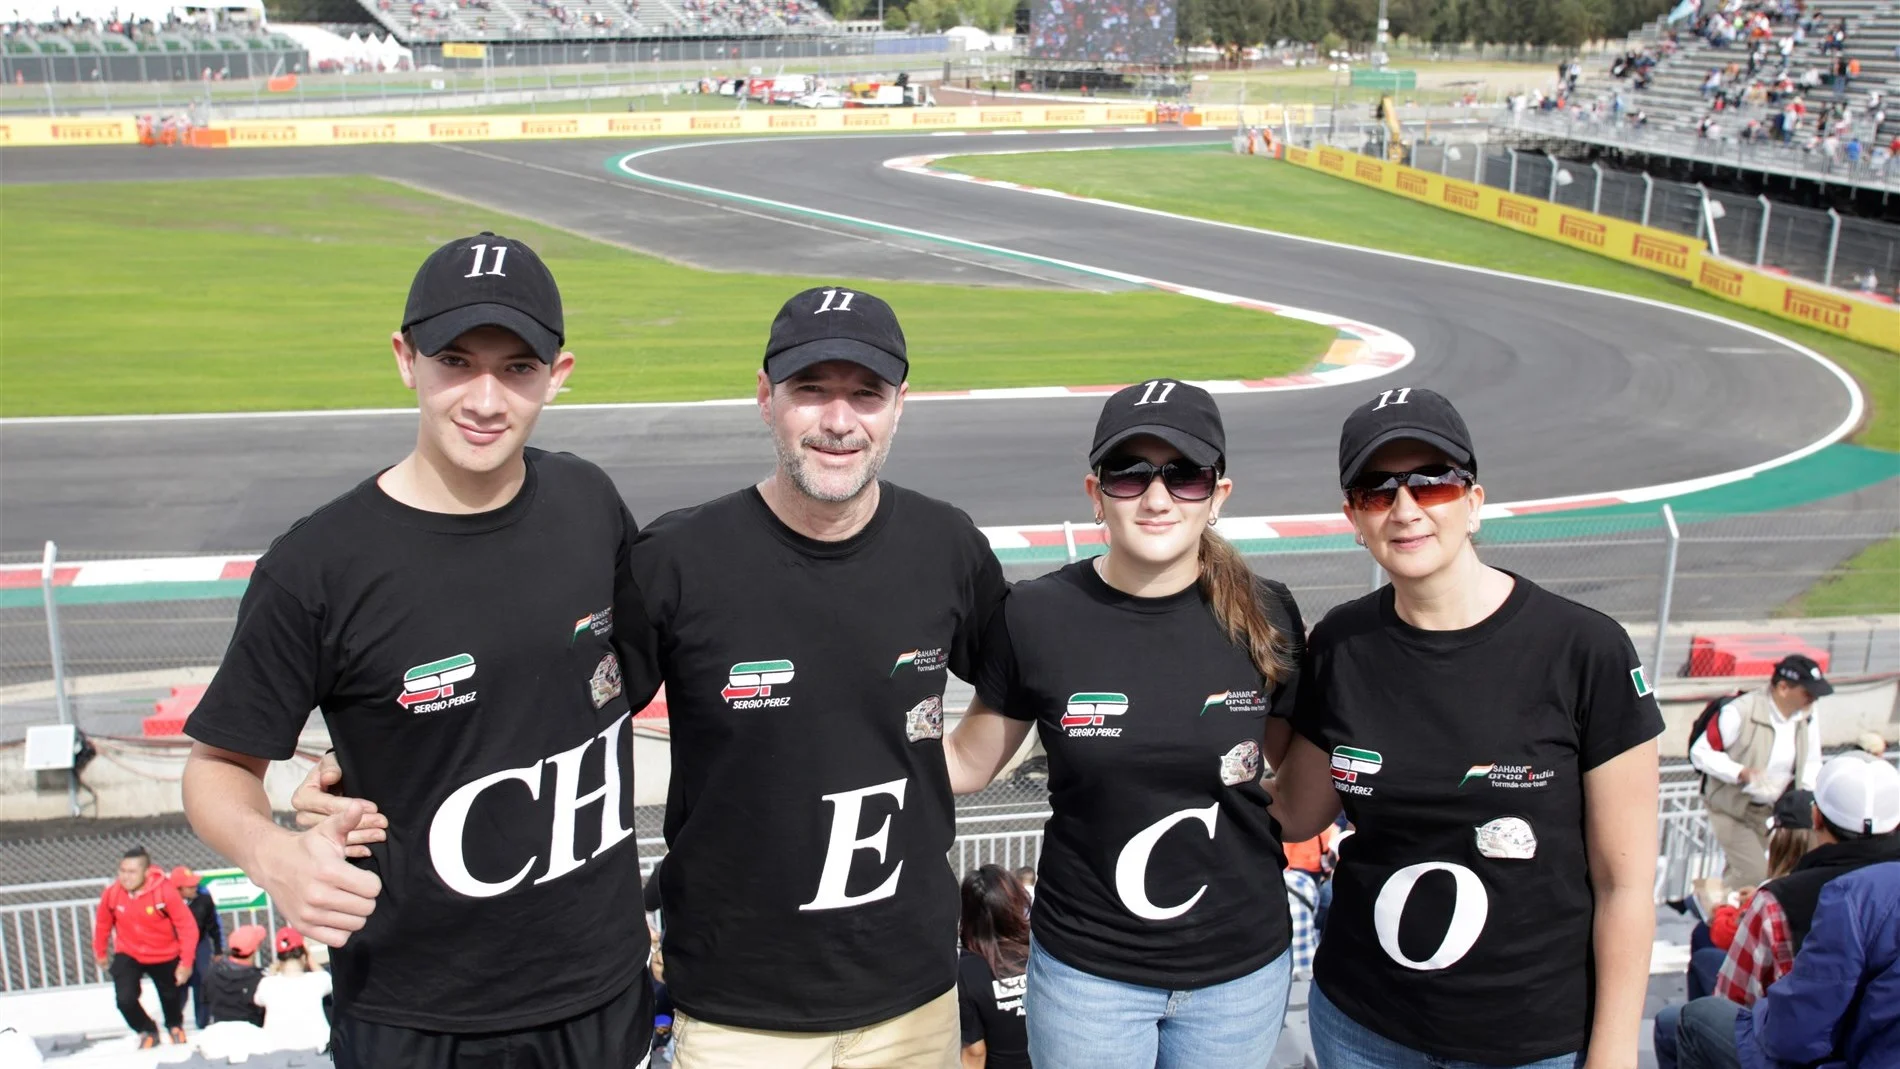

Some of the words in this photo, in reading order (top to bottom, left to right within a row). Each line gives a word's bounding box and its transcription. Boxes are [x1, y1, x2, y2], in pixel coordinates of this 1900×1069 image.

[1396, 170, 1428, 197] PIRELLI
[1443, 183, 1479, 211] PIRELLI
[1497, 197, 1538, 228] PIRELLI
[1559, 213, 1607, 248] PIRELLI
[464, 243, 508, 278] 11
[1632, 232, 1689, 270] PIRELLI
[1700, 261, 1744, 298] PIRELLI
[814, 289, 855, 314] 11
[1784, 287, 1852, 331] PIRELLI
[1134, 380, 1176, 406] 11
[1372, 387, 1411, 411] 11
[1493, 764, 1528, 774] SAHARA
[429, 710, 634, 898] CH
[799, 777, 908, 911] E
[1115, 801, 1219, 920] C
[1374, 861, 1489, 970] O
